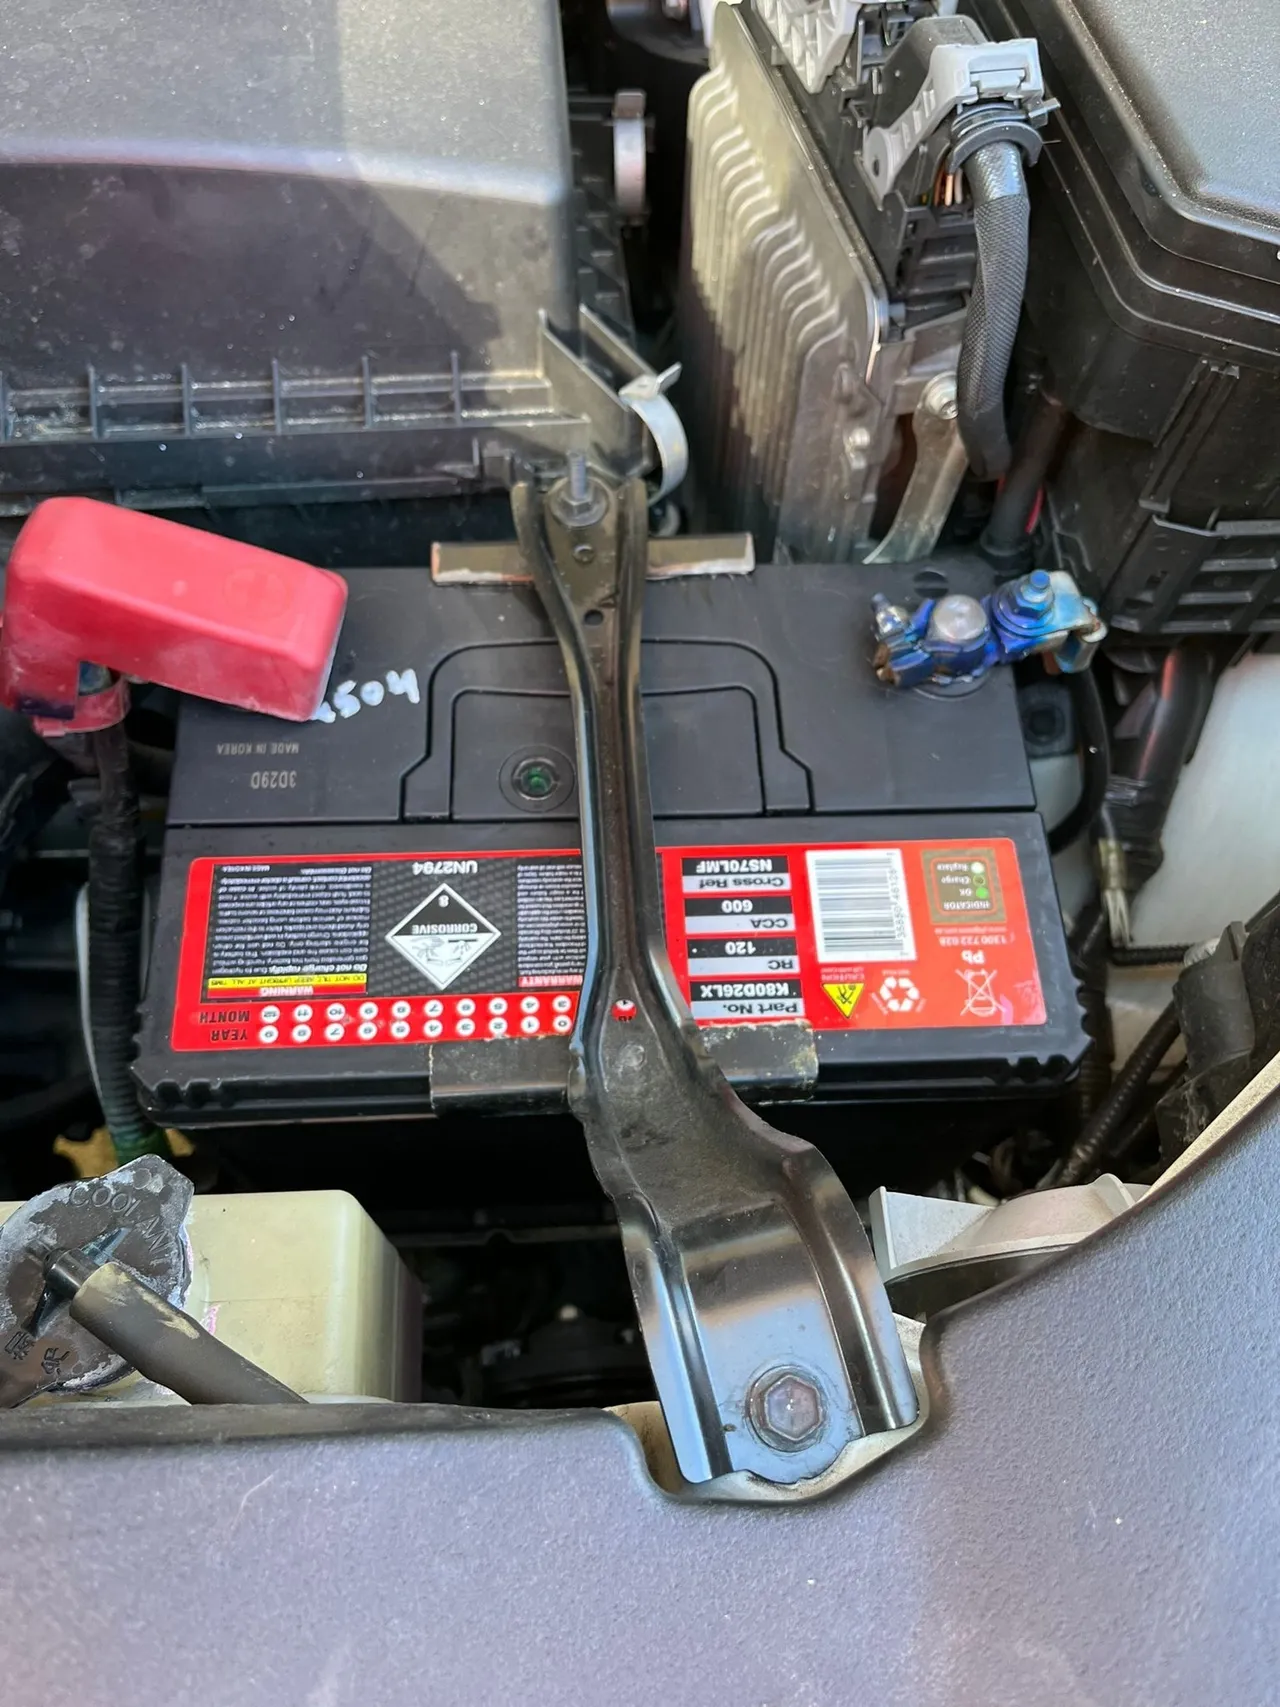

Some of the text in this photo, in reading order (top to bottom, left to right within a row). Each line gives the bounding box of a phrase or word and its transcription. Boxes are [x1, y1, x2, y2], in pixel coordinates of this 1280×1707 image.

[217, 743, 299, 755] MADE IN KOREA
[251, 770, 297, 790] 3D29D
[412, 860, 478, 875] UN2794
[696, 859, 773, 874] NS70LMF
[699, 876, 784, 888] Cross Ref
[438, 895, 450, 908] 8
[721, 899, 753, 913] 600
[943, 901, 990, 910] INDICATOR
[412, 923, 478, 934] CORROSIVE
[750, 918, 788, 928] CCA
[725, 941, 756, 954] 120
[961, 949, 985, 965] Pb
[767, 959, 793, 970] RC
[259, 985, 314, 997] WARNING
[700, 982, 789, 998] K80D26LX
[723, 1003, 800, 1014] Part No.
[199, 1010, 250, 1024] MONTH
[211, 1028, 248, 1041] YEAR
